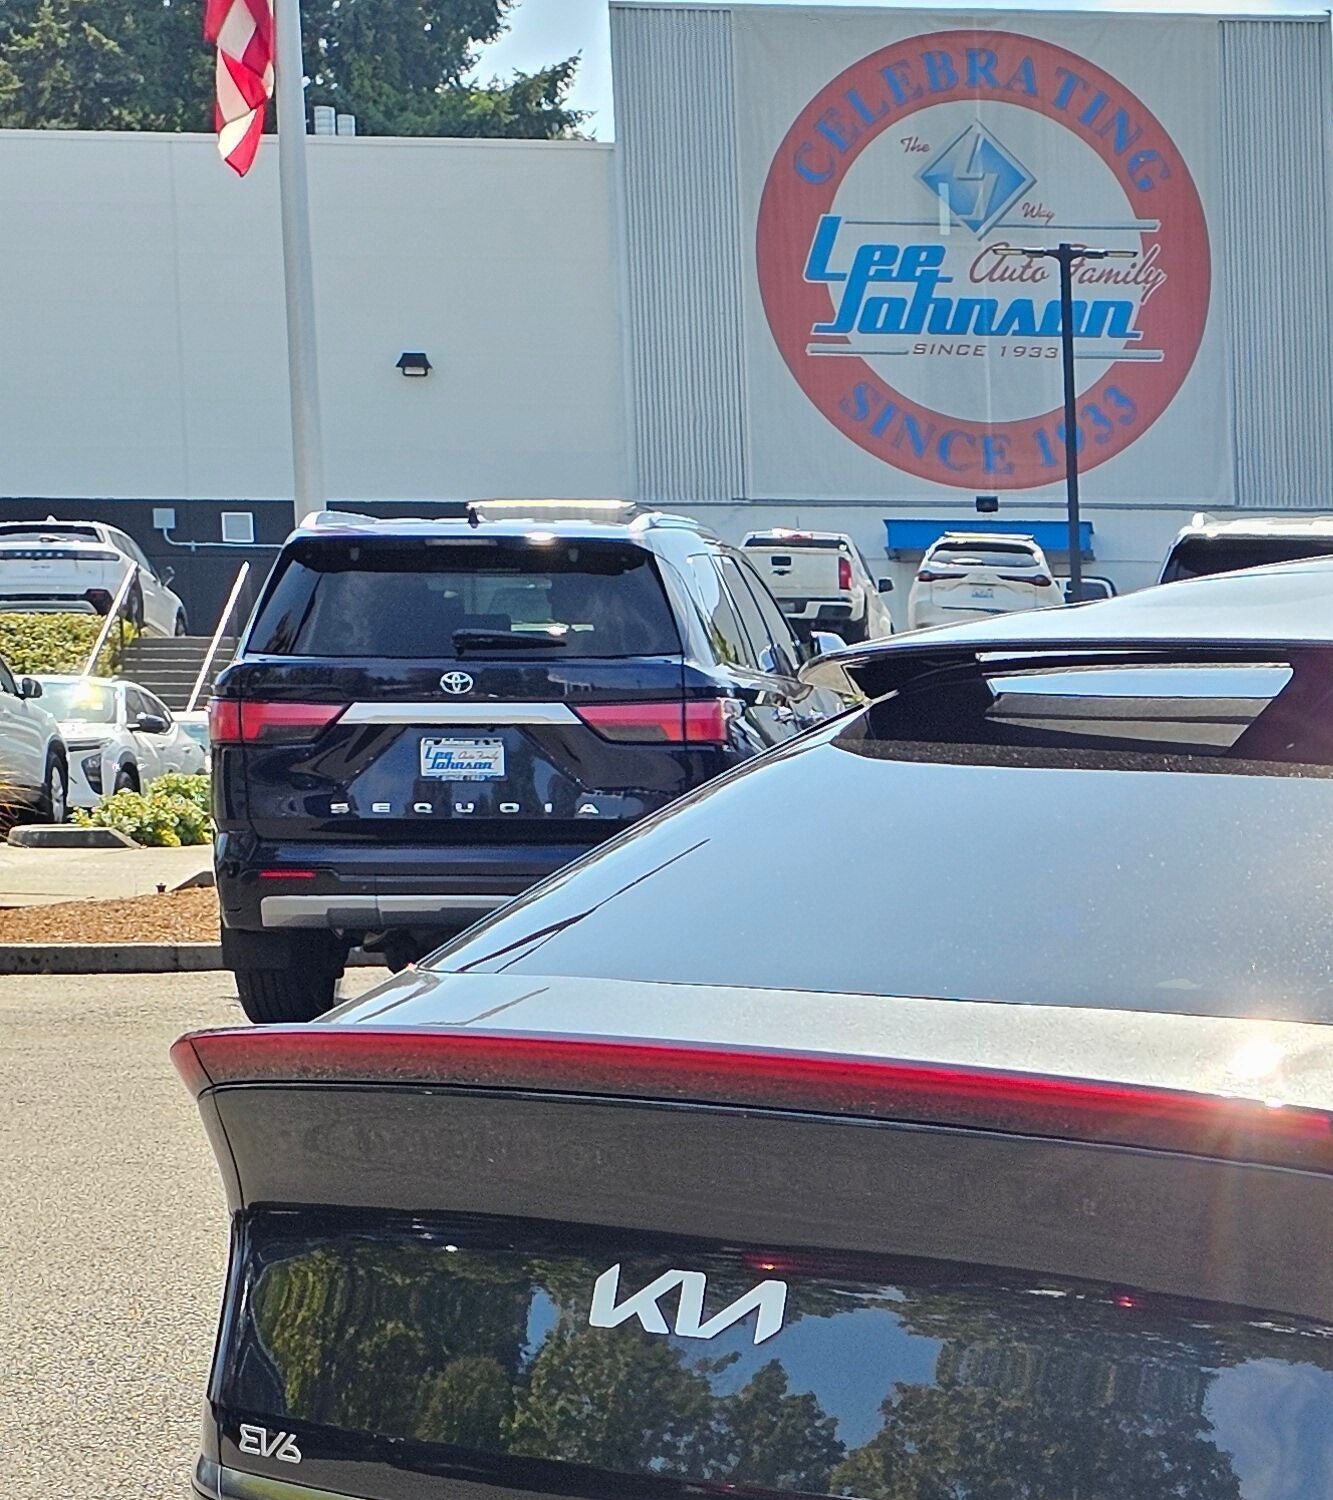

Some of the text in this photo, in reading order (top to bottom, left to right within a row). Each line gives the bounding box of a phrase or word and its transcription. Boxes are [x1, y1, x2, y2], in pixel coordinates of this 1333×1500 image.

[792, 47, 1171, 193] CELEBRATING
[901, 136, 931, 154] The
[1021, 202, 1055, 224] Way
[804, 215, 954, 283] Lee
[969, 242, 1050, 284] Auto
[813, 262, 1143, 339] Johnson
[912, 343, 1059, 359] SINCE 1933
[840, 380, 1137, 475] SINCE 1933
[329, 802, 600, 814] SEQUOIA
[588, 1262, 788, 1345] KIA
[238, 1423, 302, 1465] EV6
